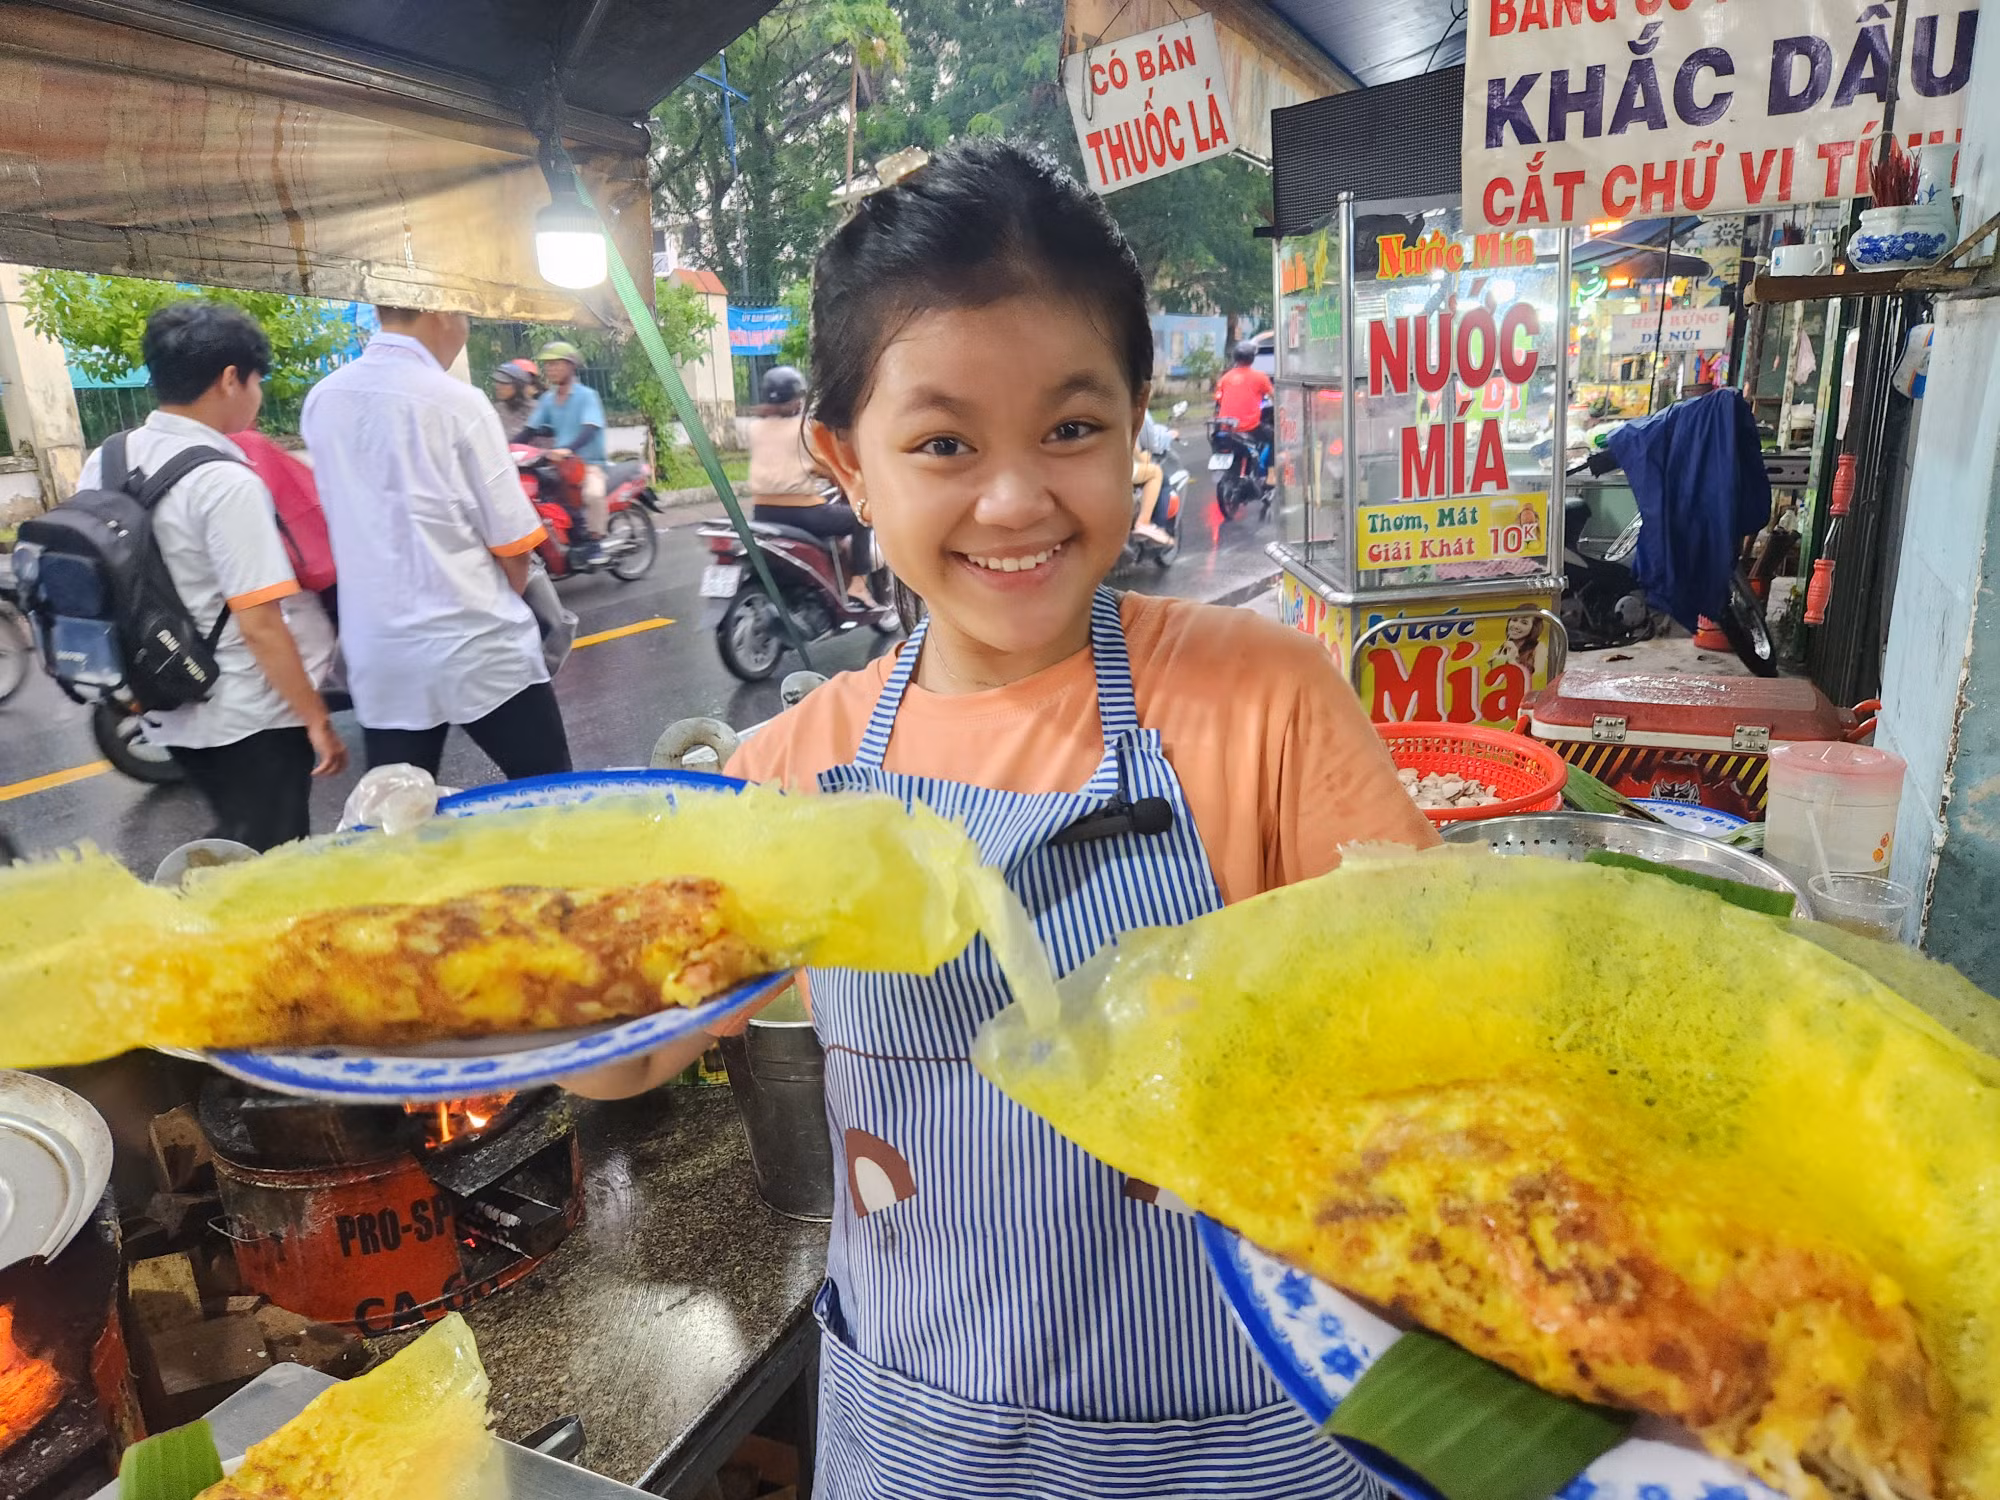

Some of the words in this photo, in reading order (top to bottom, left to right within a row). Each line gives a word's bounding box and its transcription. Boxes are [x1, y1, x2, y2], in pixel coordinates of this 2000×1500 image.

[1091, 48, 1129, 96] CÓ
[1135, 34, 1197, 82] BÁN
[1485, 21, 1735, 149] KHẮC
[1086, 87, 1185, 186] THUỐC
[1187, 77, 1230, 153] LÁ
[1483, 150, 1585, 226] CẮT
[1602, 139, 1725, 218] CHỮ
[1740, 147, 1795, 205] VI
[1376, 229, 1464, 280] Nước
[1470, 231, 1536, 270] Mía
[1369, 276, 1541, 396] NƯỚC
[1401, 399, 1509, 499] MÍA
[1367, 513, 1429, 534] Thơm,
[1436, 506, 1479, 528] Mát
[1367, 541, 1412, 564] Giải
[1418, 537, 1476, 560] Khát
